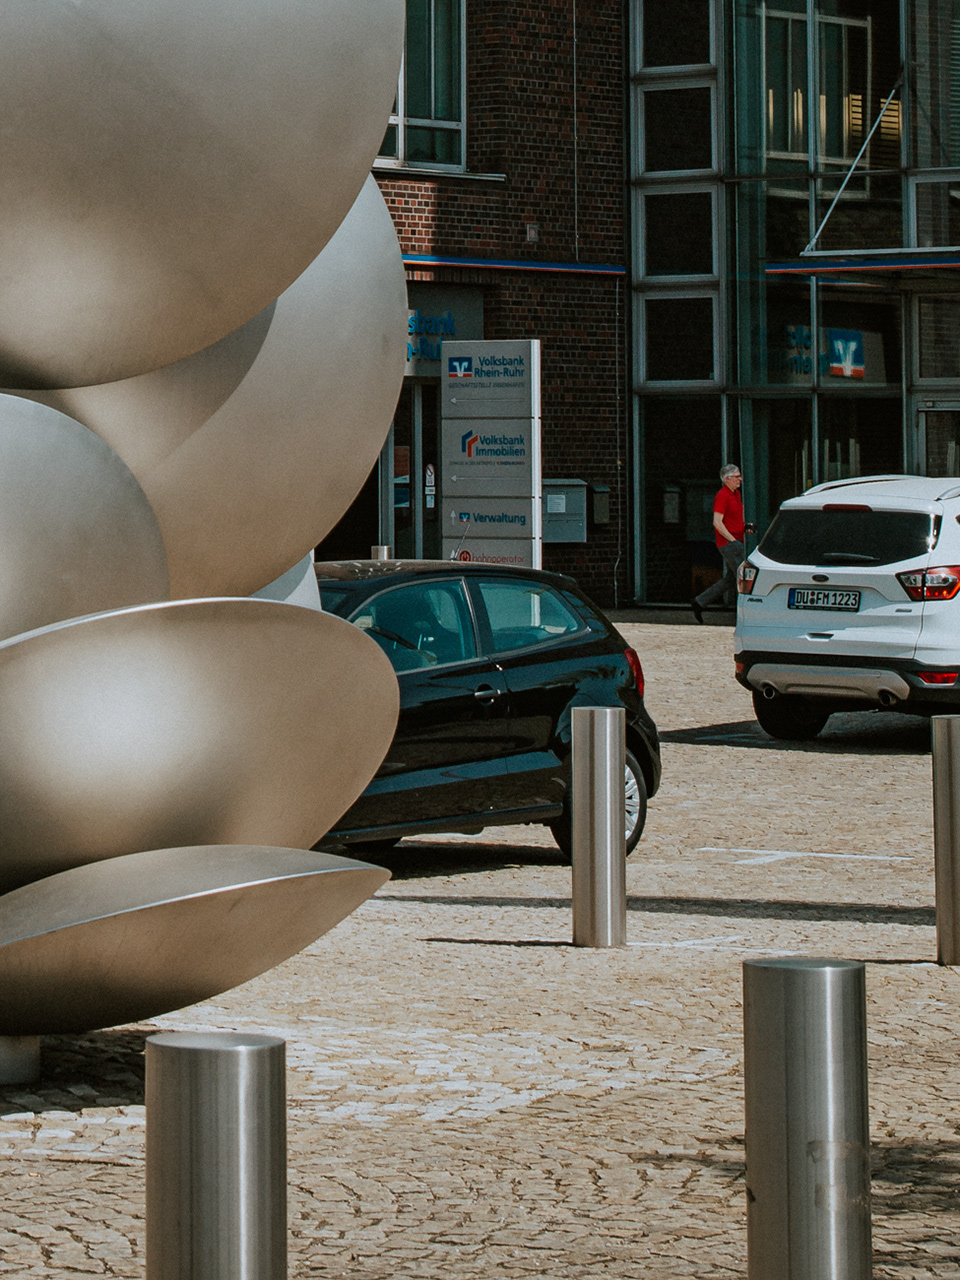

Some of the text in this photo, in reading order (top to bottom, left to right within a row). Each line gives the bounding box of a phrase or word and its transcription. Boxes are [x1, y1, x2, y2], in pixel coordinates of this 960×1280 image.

[478, 355, 525, 366] Volksbank
[474, 367, 525, 378] Rhein-Ruhr
[479, 434, 525, 445] Volksbank
[475, 446, 526, 457] Immobilien
[472, 512, 526, 526] Verwaltung
[831, 593, 858, 607] 1223
